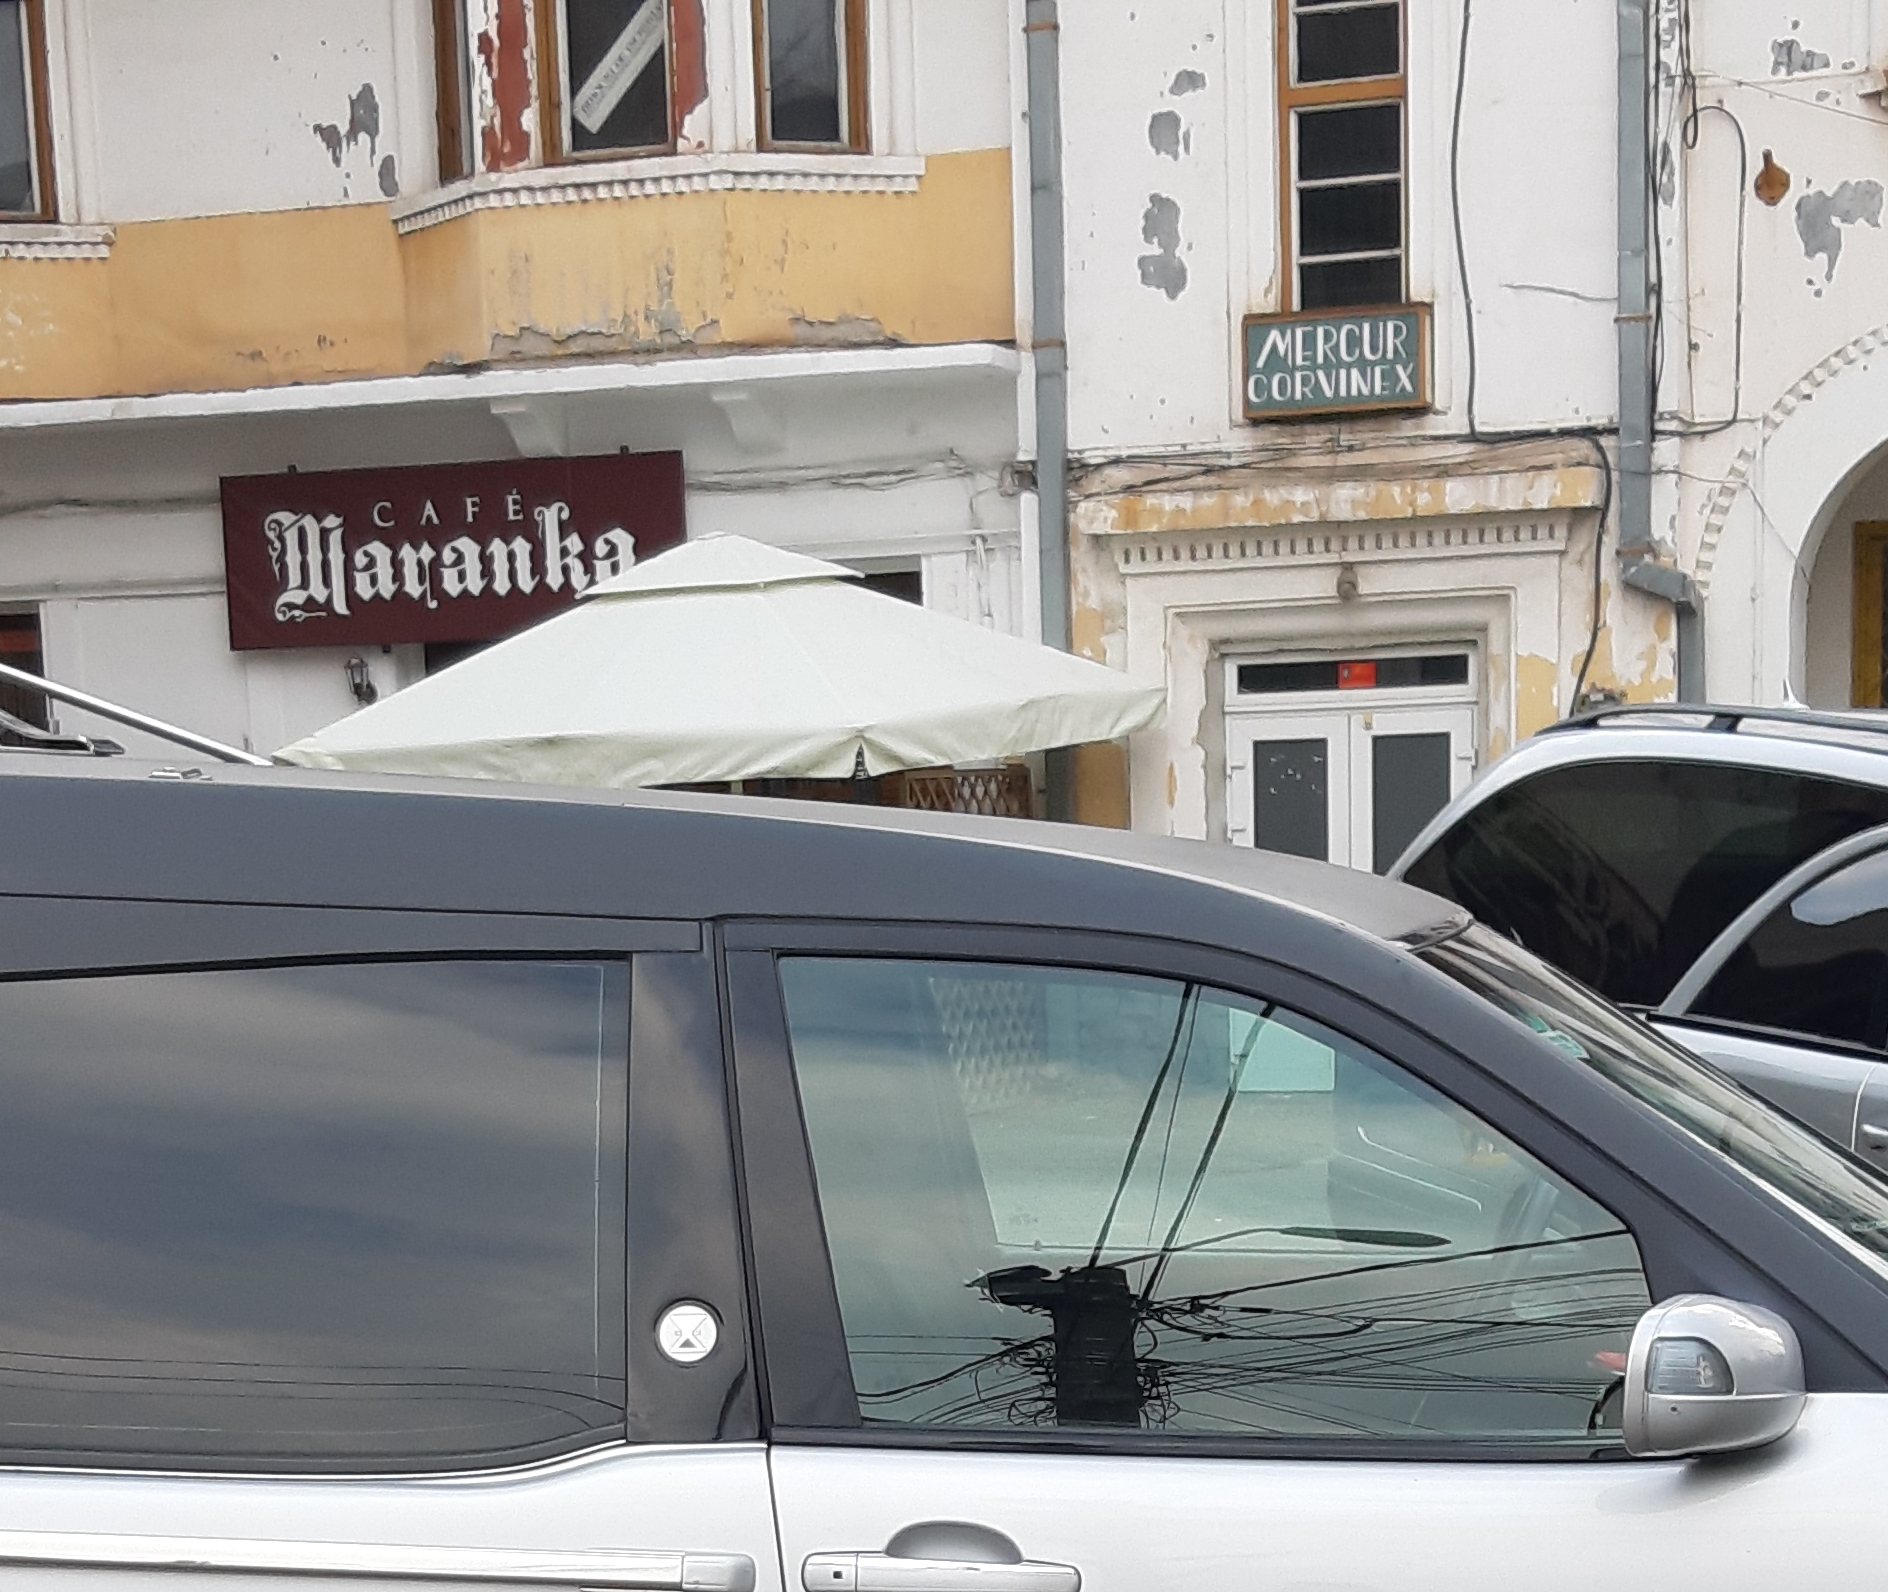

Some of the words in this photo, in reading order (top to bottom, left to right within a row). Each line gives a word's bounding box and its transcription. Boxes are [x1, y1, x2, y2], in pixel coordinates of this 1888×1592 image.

[1256, 319, 1408, 369] MERCUR
[1248, 363, 1414, 403] CORVINEX
[373, 488, 524, 527] CAFÉ
[264, 501, 638, 622] Maranka
